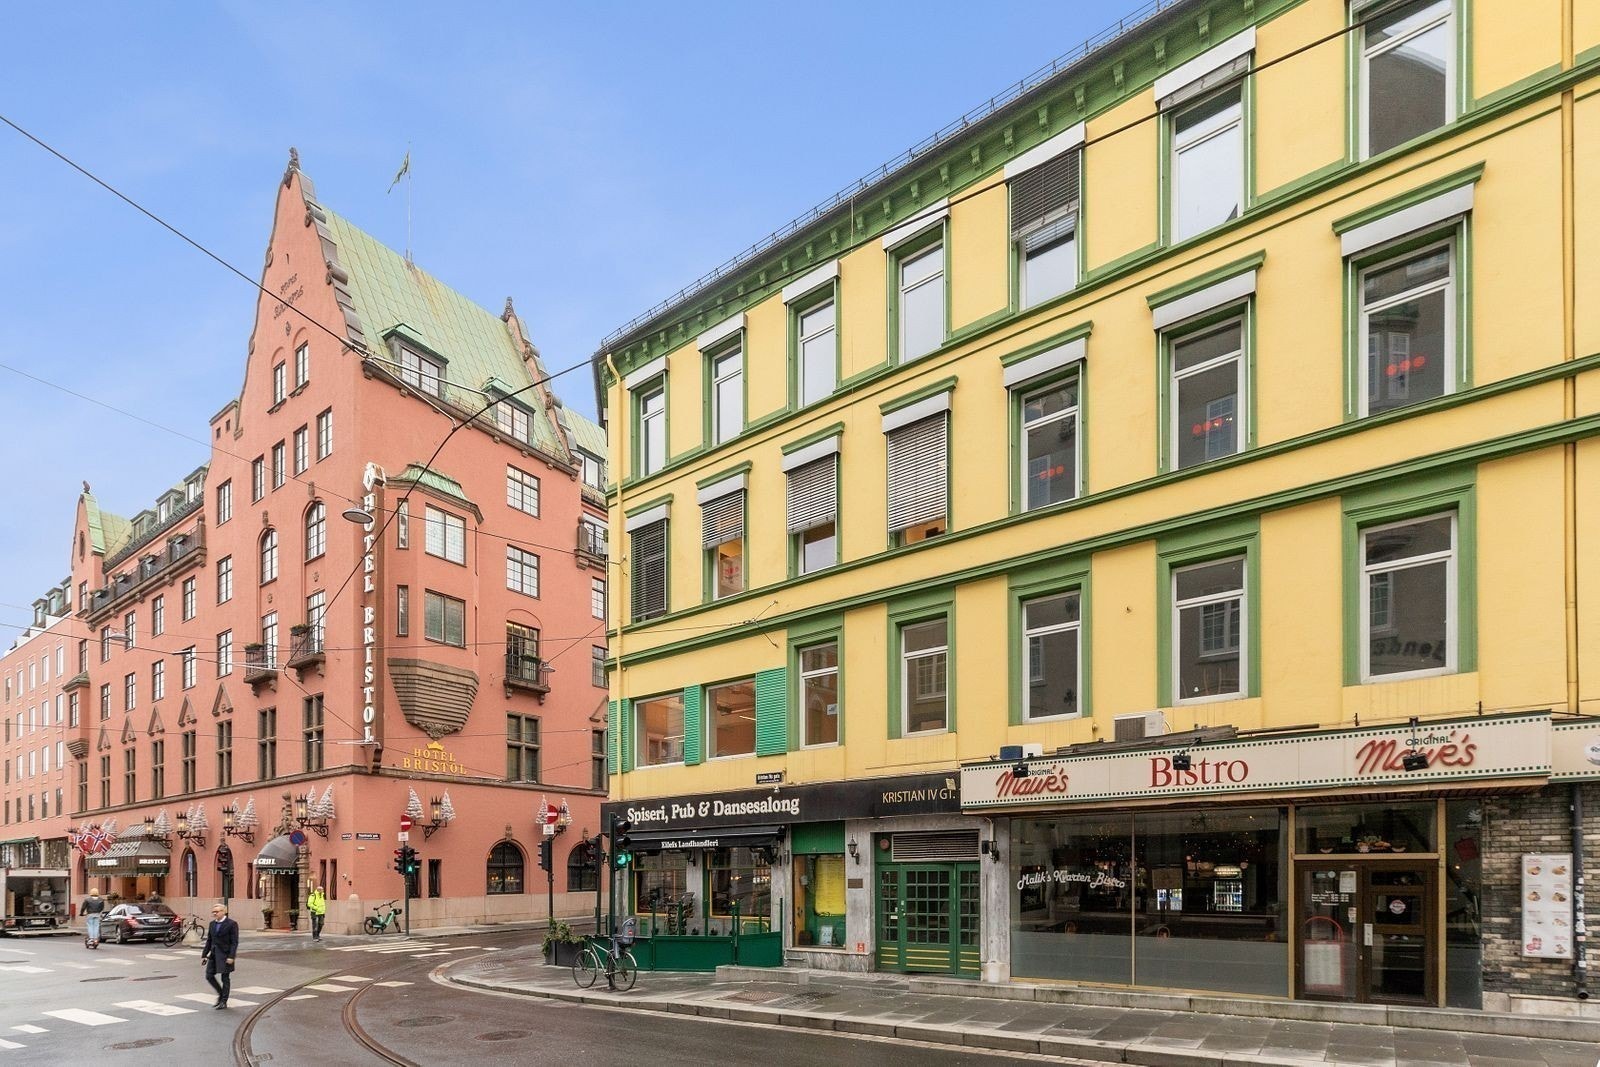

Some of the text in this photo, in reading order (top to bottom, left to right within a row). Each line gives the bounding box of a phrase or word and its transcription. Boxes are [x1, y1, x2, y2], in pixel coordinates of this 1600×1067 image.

[363, 493, 376, 593] HOTEL
[363, 606, 376, 743] BRISTOL
[1404, 735, 1452, 747] ORIGINAL
[414, 748, 456, 762] HOTEL
[403, 757, 468, 775] BRISTOL
[1148, 756, 1250, 788] Bistro
[882, 789, 926, 804] KRISTIAN
[927, 788, 938, 801] IV
[627, 796, 800, 825] Spiseri, Pub & Dansesalong
[1017, 870, 1052, 890] Malik's
[1089, 872, 1126, 889] Bistro
